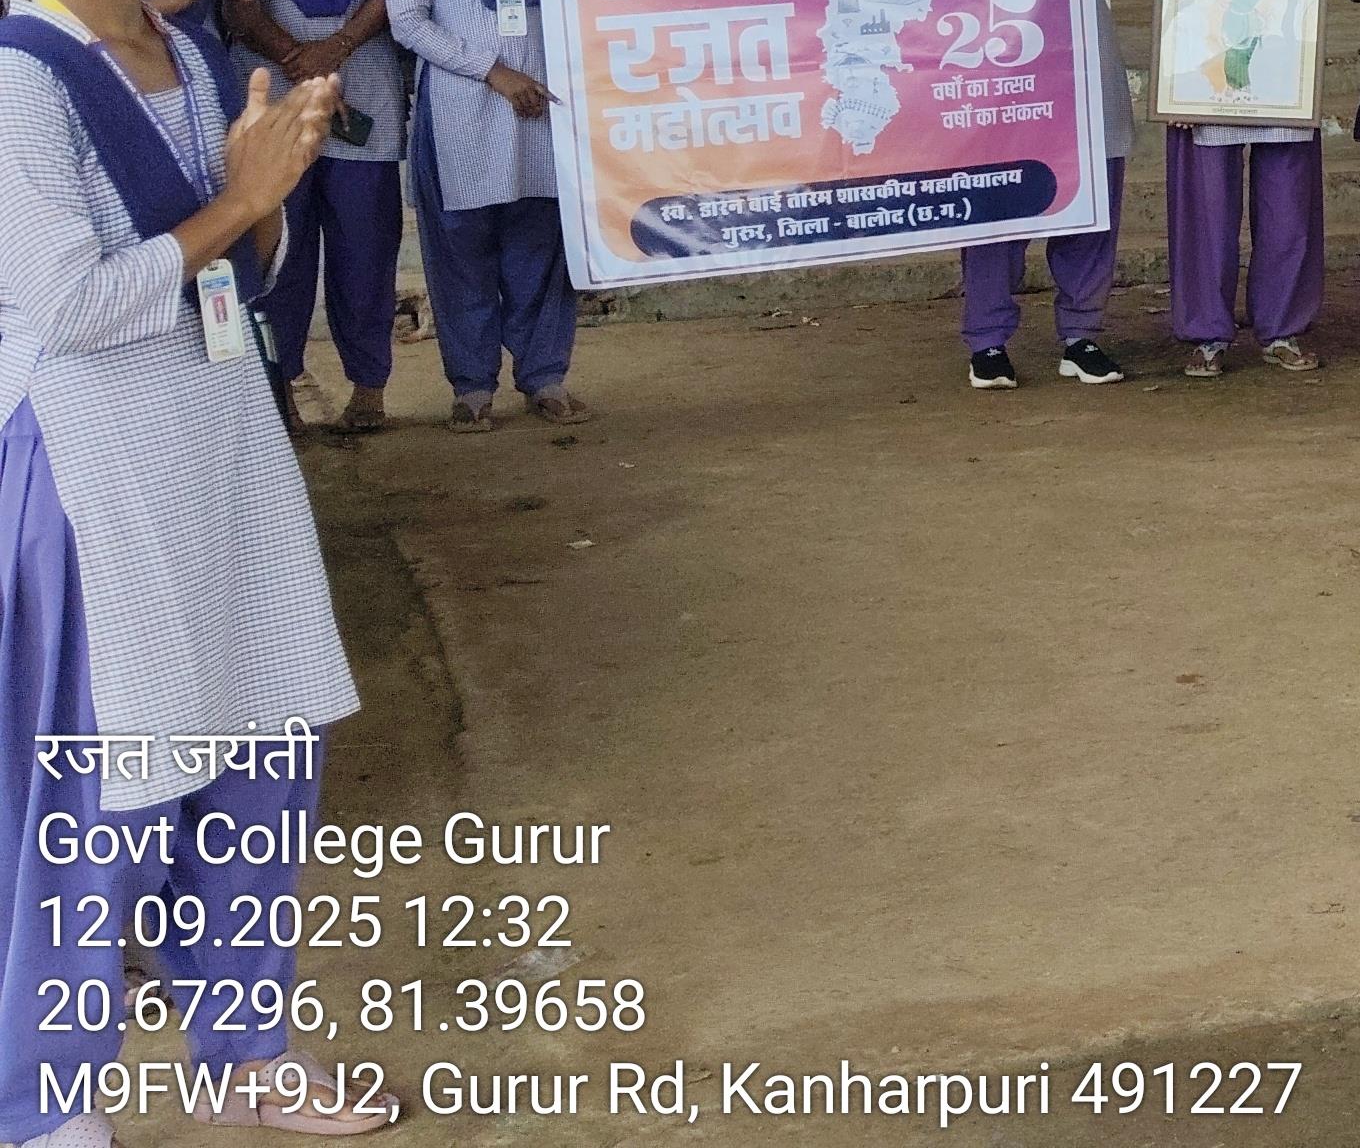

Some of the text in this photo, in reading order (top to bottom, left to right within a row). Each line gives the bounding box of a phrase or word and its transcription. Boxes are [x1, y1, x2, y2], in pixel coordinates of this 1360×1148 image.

[596, 4, 795, 93] रजत
[965, 78, 989, 98] का
[991, 74, 1036, 96] उत्सव
[604, 87, 804, 153] महोत्सव
[973, 107, 999, 127] का
[1000, 101, 1054, 124] संकल्प
[786, 188, 833, 210] तारम
[836, 178, 917, 205] शासकीय
[919, 168, 1023, 196] महाविद्यालय
[777, 218, 829, 240] जिला
